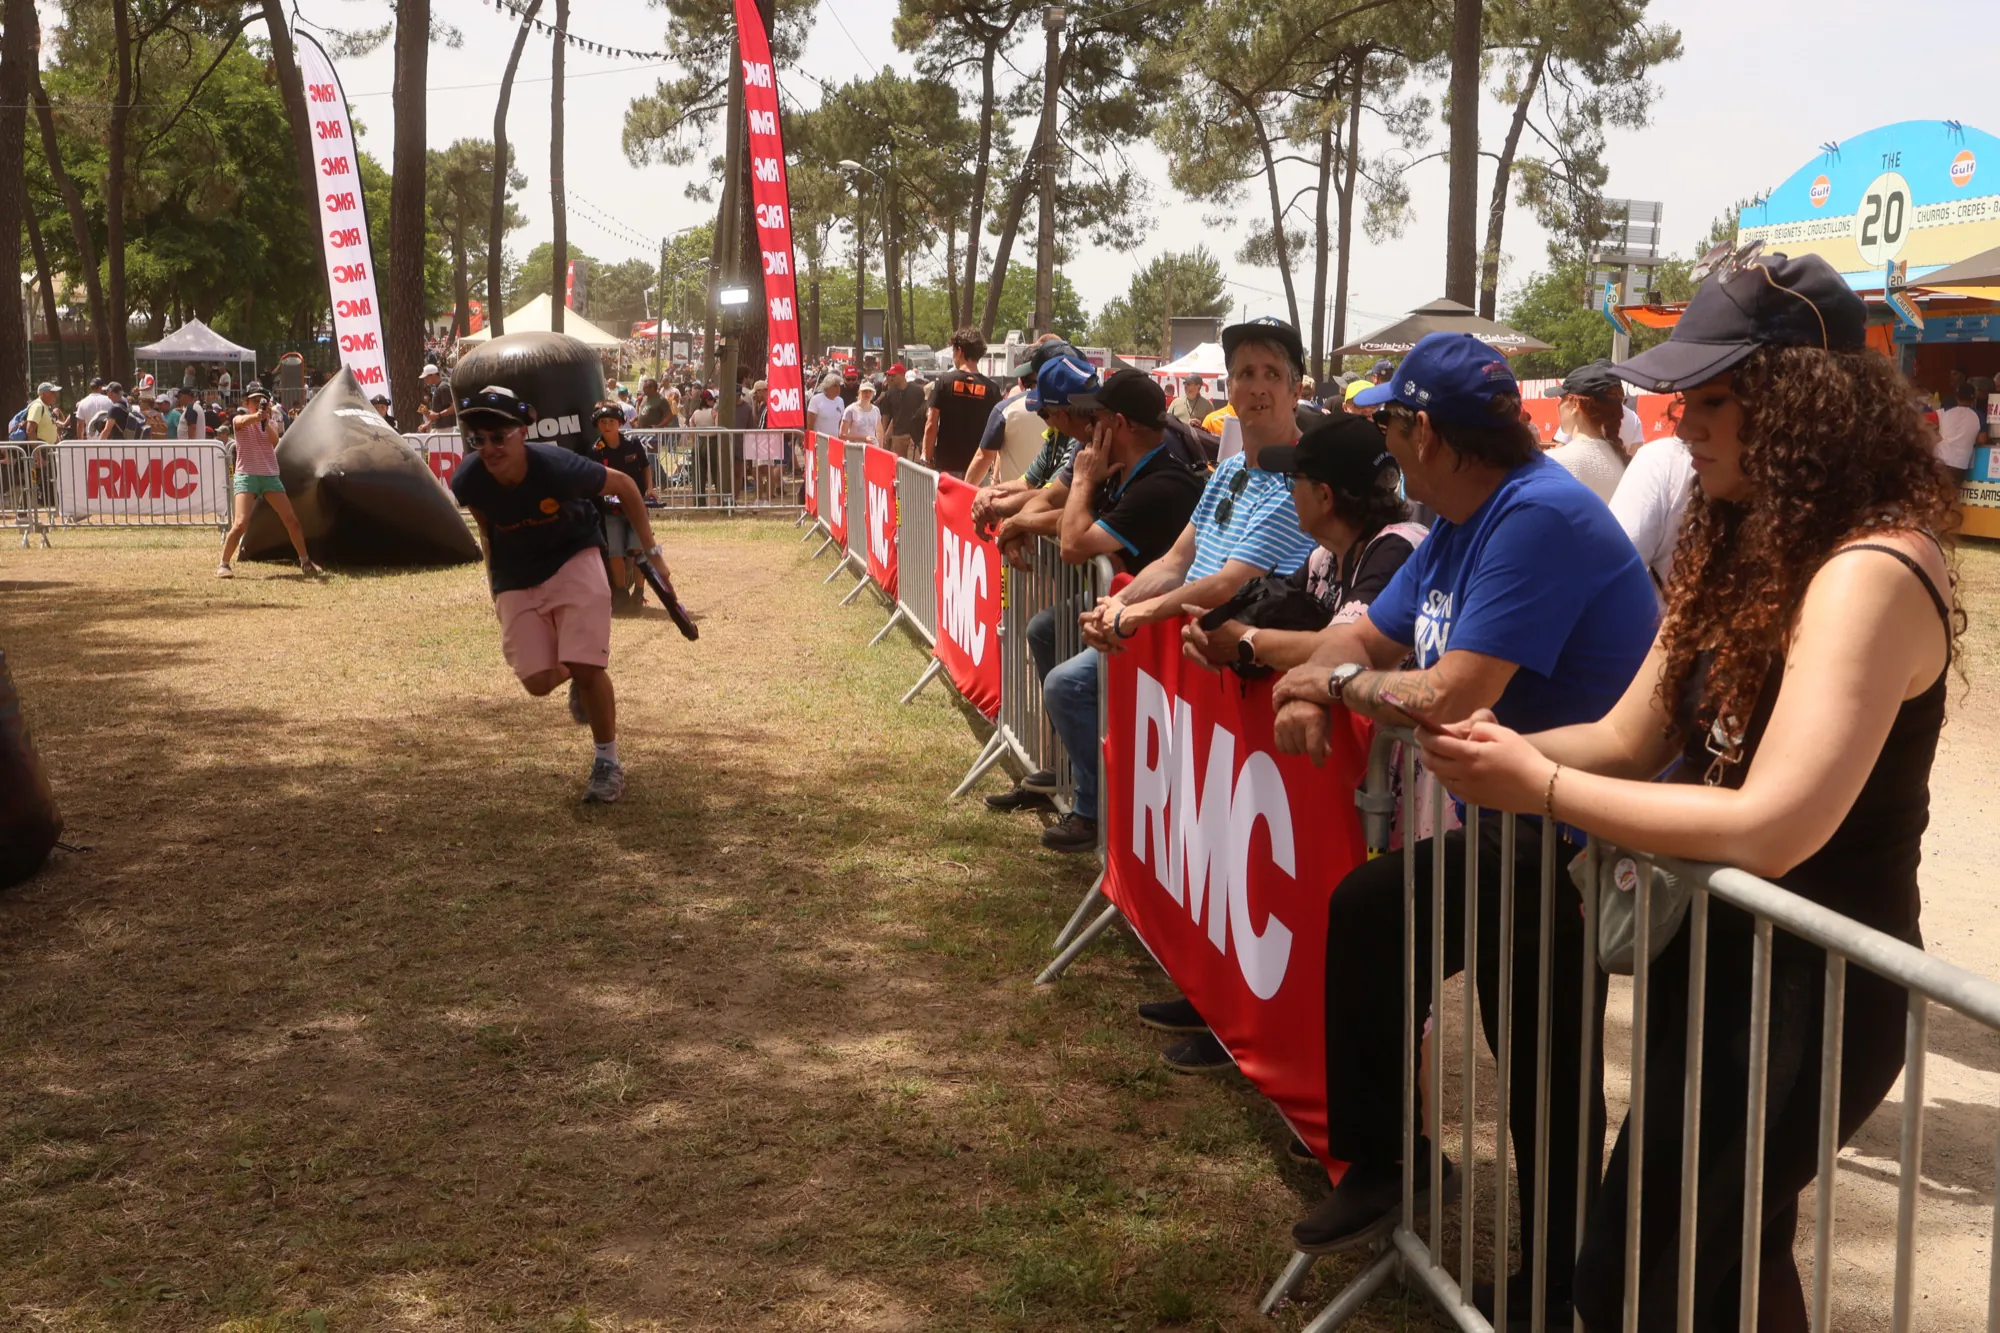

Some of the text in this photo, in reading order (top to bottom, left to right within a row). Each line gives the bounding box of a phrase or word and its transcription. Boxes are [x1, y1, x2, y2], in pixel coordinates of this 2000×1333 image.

[1882, 151, 1901, 170] THE
[1951, 162, 1975, 175] Gulf
[1810, 186, 1830, 197] Gulf
[1861, 190, 1904, 246] 20
[1917, 207, 1950, 223] CHURROS
[1957, 202, 1986, 218] CREPES
[1774, 226, 1802, 240] BEIGNETS
[1807, 220, 1851, 236] CROUSTILLONS
[1890, 275, 1903, 287] 20
[1607, 294, 1617, 303] 20
[1896, 297, 1916, 319] CREPES
[87, 458, 199, 500] RMC
[942, 525, 988, 667] RMC
[1133, 667, 1297, 1001] RMC
